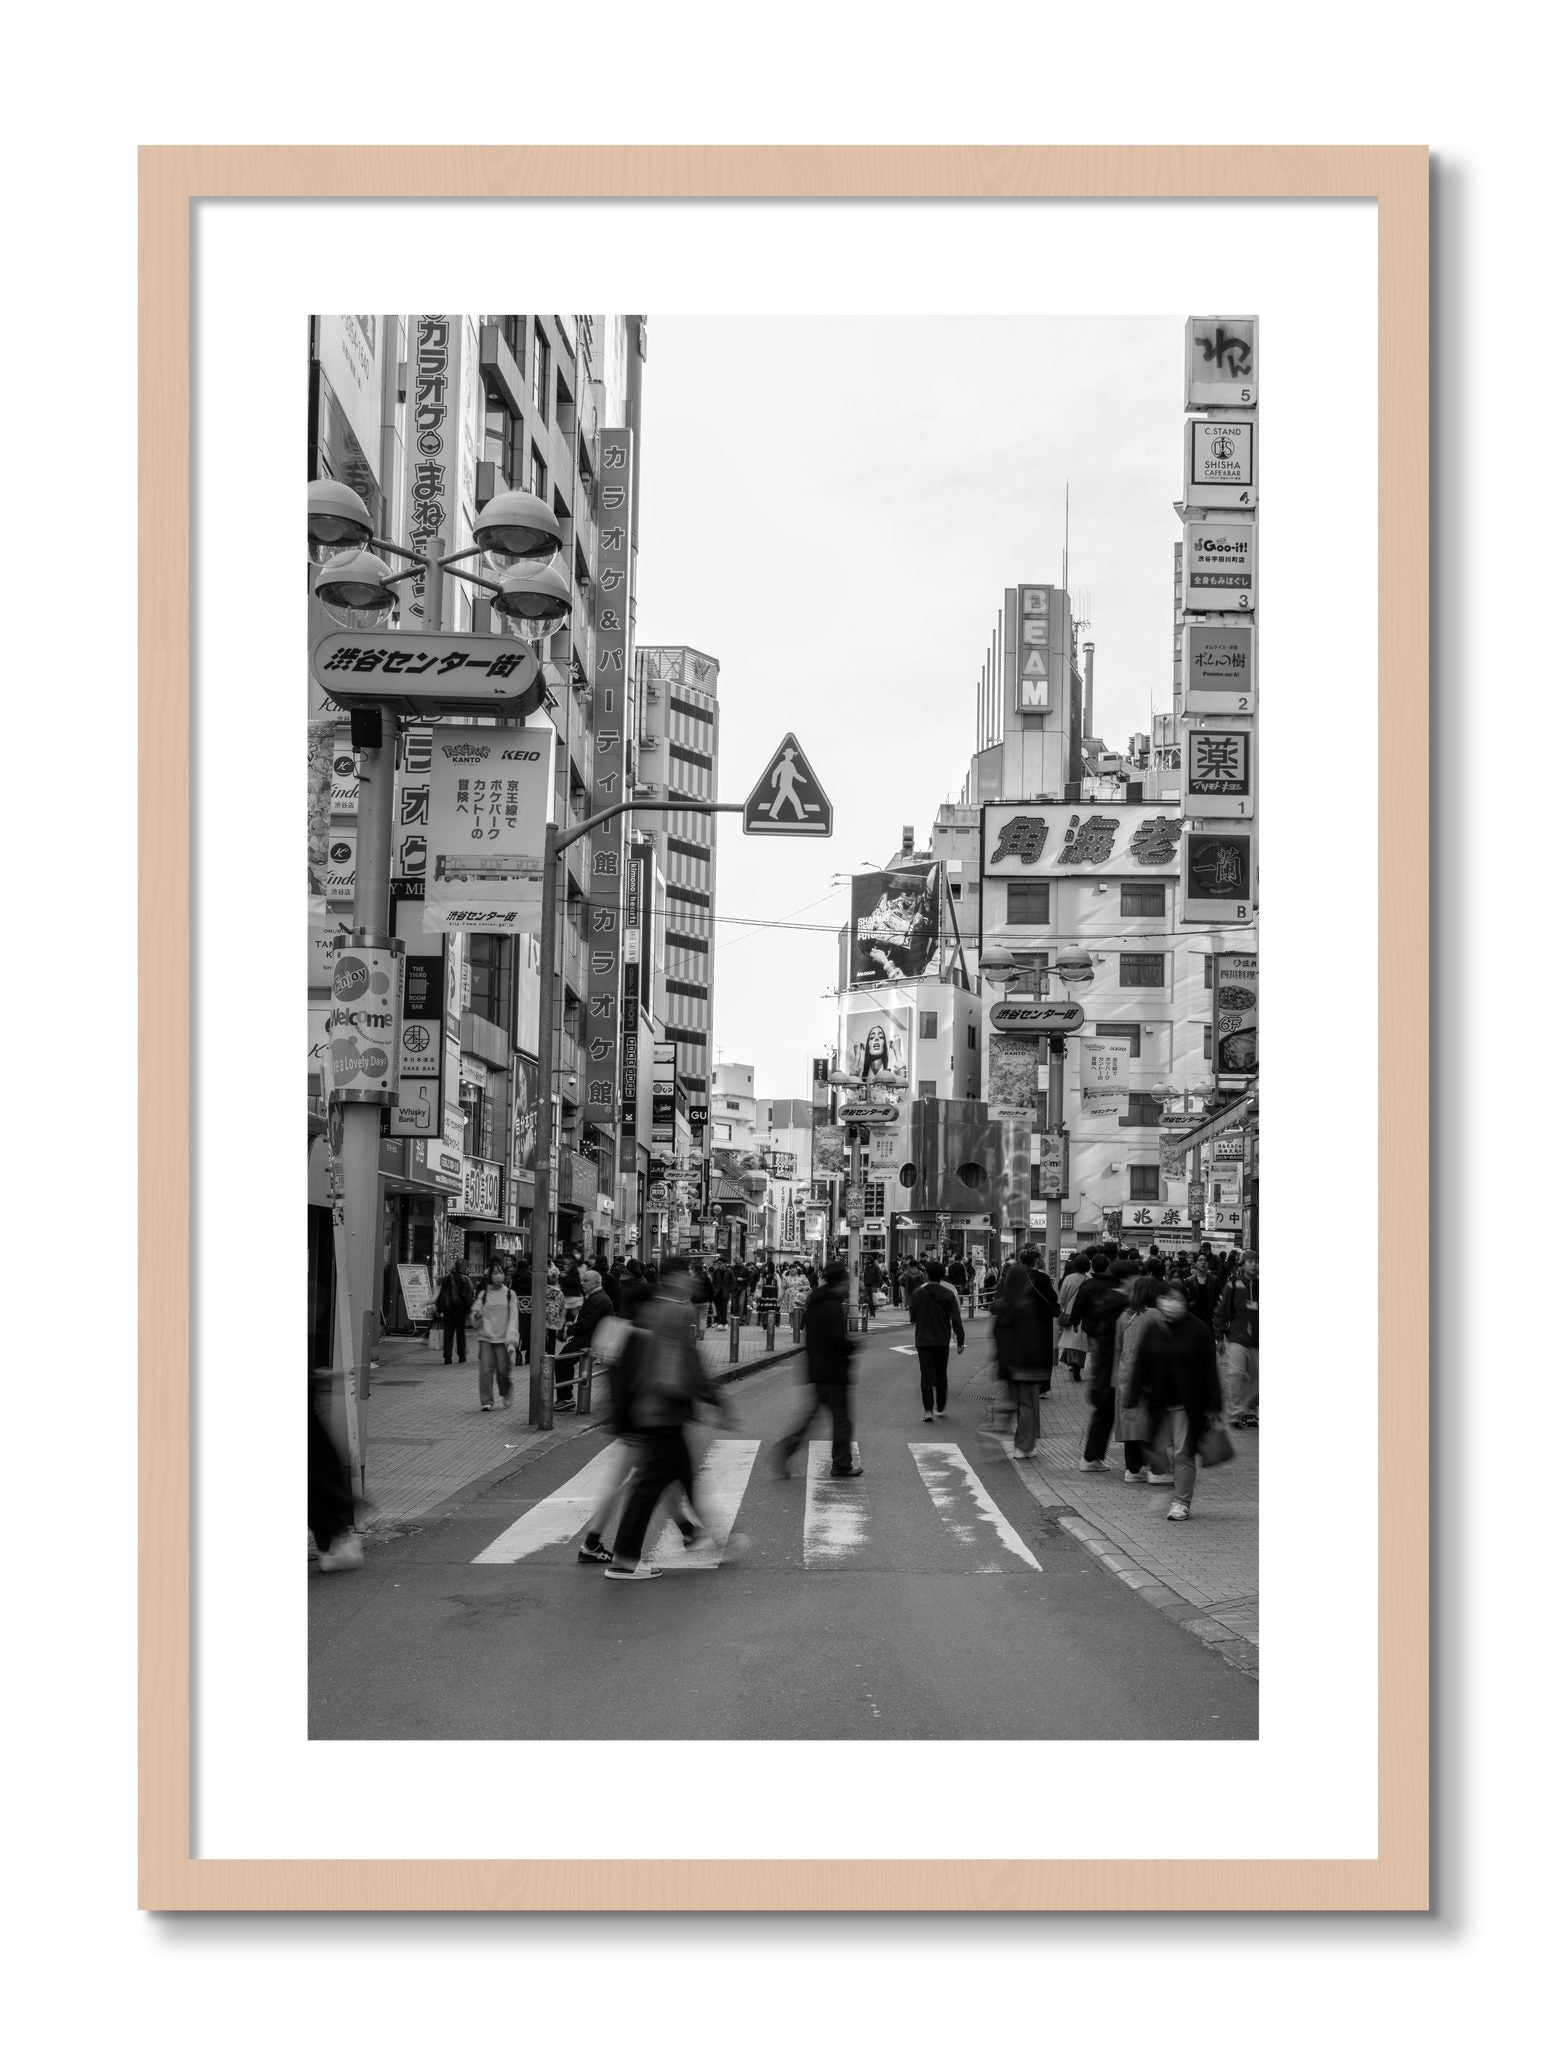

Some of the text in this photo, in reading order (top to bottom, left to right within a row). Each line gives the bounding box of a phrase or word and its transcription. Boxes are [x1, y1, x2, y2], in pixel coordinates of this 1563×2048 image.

[1241, 389, 1251, 401] 5
[1205, 427, 1241, 435] C.STAND
[1205, 461, 1240, 469] SHISHA
[1240, 492, 1249, 504] 4
[1204, 540, 1248, 553] Goo-it!
[1194, 576, 1249, 586] 全身もみほぐし
[1239, 594, 1249, 608] 3
[1022, 588, 1049, 706] BEAM
[324, 648, 526, 678] 渋谷センター街
[1238, 697, 1248, 710] 2
[501, 750, 541, 761] KEIO
[1197, 737, 1238, 778] 薬
[456, 779, 469, 813] 冒険へ
[471, 779, 485, 839] カントーの
[505, 780, 519, 828] 京王線で
[1238, 801, 1245, 814] 1
[990, 815, 1183, 864] 角海老
[446, 911, 518, 921] 渋谷センター街
[1237, 906, 1246, 918] B
[334, 967, 367, 995] Enjoy
[329, 1007, 393, 1028] Welcome
[996, 1009, 1079, 1020] 渋谷センター街
[1219, 1016, 1242, 1032] 6F
[399, 1108, 426, 1117] Whisky
[691, 1111, 707, 1120] GU
[1133, 1208, 1181, 1225] 兆楽
